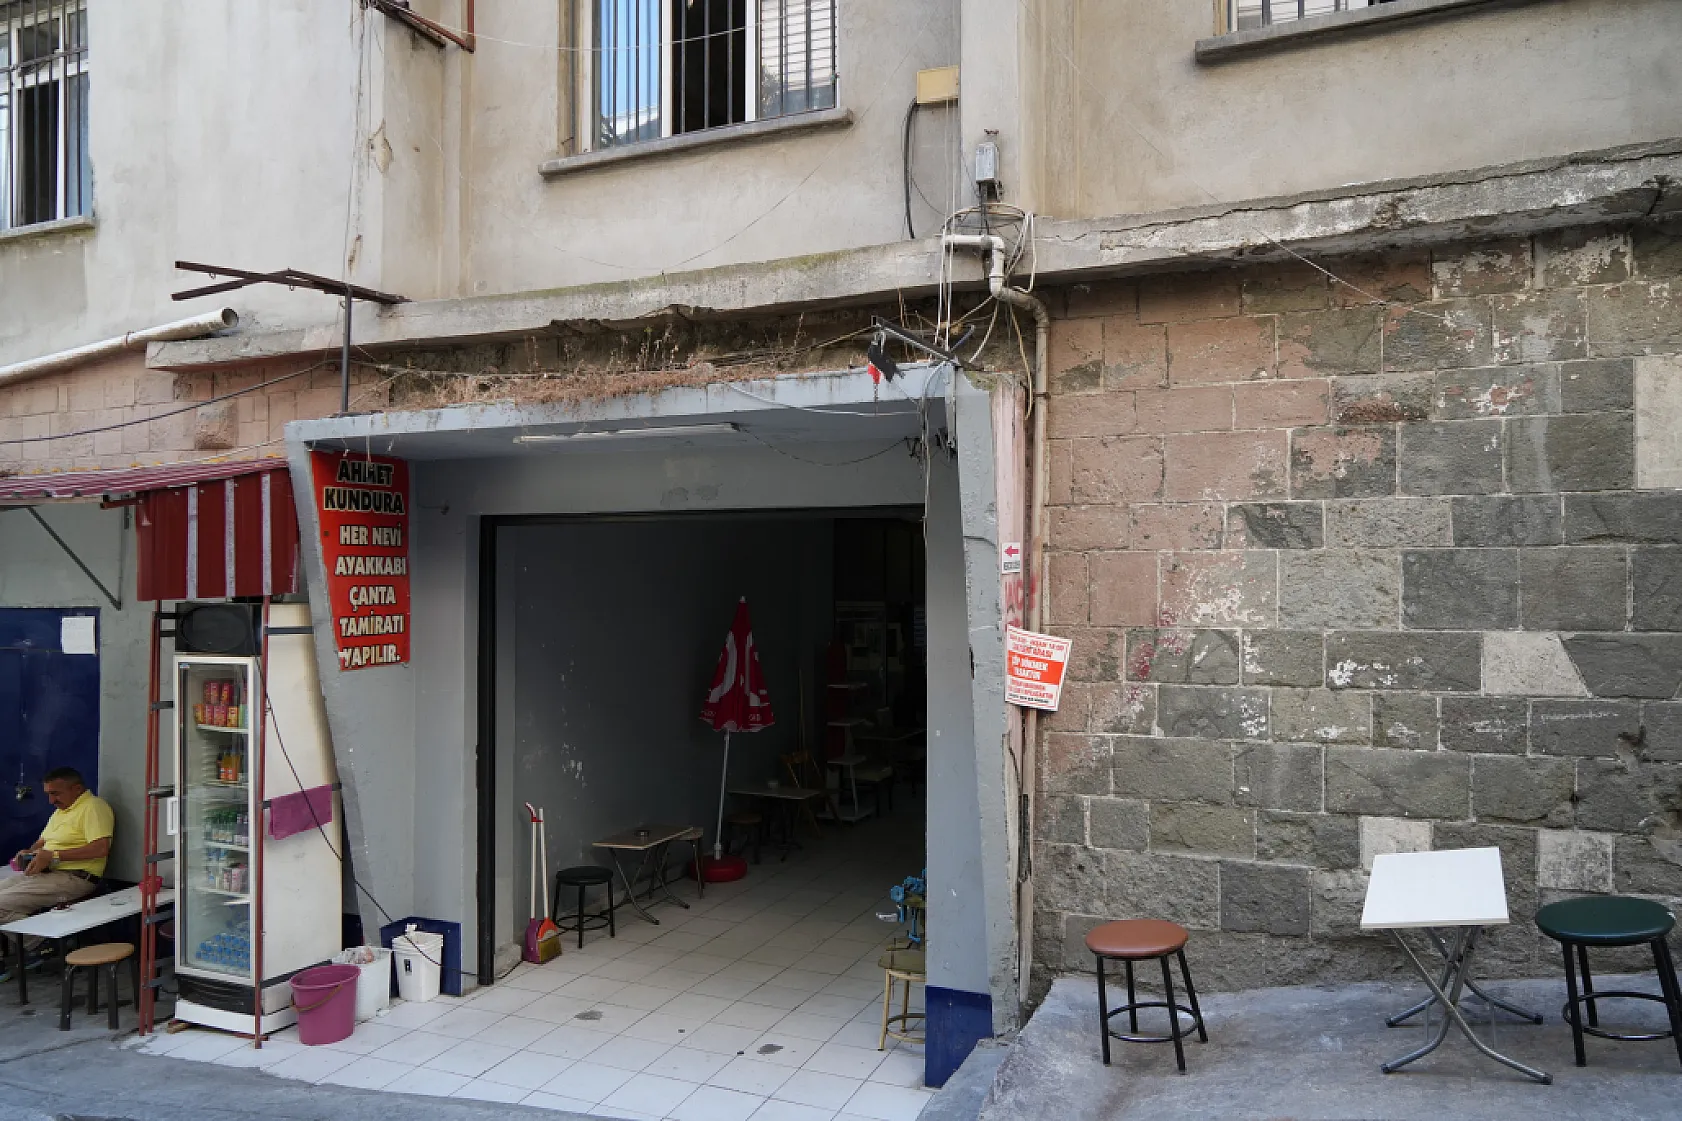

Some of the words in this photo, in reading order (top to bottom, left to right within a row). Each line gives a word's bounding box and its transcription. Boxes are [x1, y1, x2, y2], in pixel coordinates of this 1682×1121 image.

[337, 459, 394, 486] AHMET
[323, 486, 406, 516] KUNDURA
[339, 525, 369, 546] HER
[372, 522, 403, 547] NEVİ
[334, 555, 407, 576] AYAKKABI
[349, 586, 397, 612] ÇANTA
[339, 611, 405, 637] TAMİRATI
[340, 643, 401, 669] YAPILIR.
